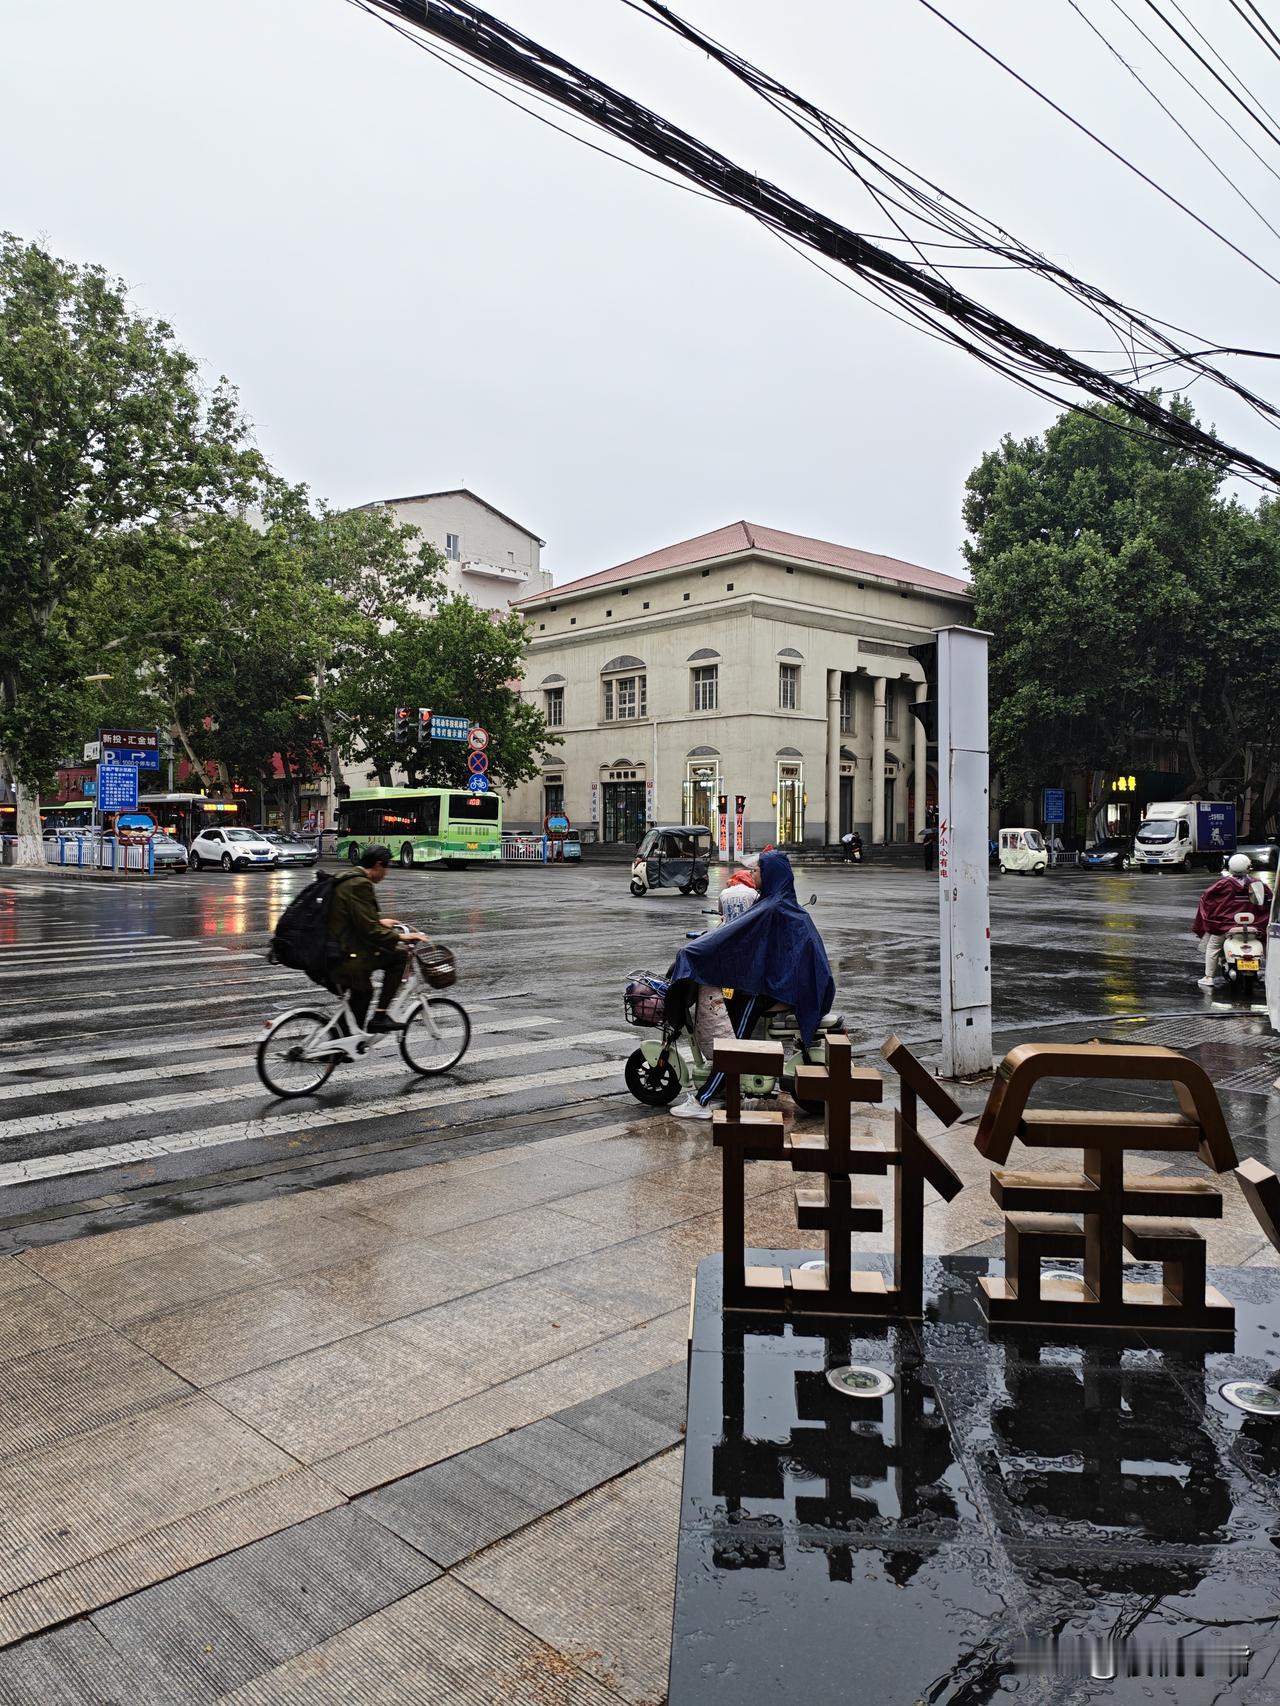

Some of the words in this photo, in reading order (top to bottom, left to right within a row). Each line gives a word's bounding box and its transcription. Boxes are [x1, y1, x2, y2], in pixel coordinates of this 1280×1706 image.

[103, 734, 156, 746] 新投·汇金城
[104, 751, 115, 765] P
[939, 838, 949, 878] 小心有电
